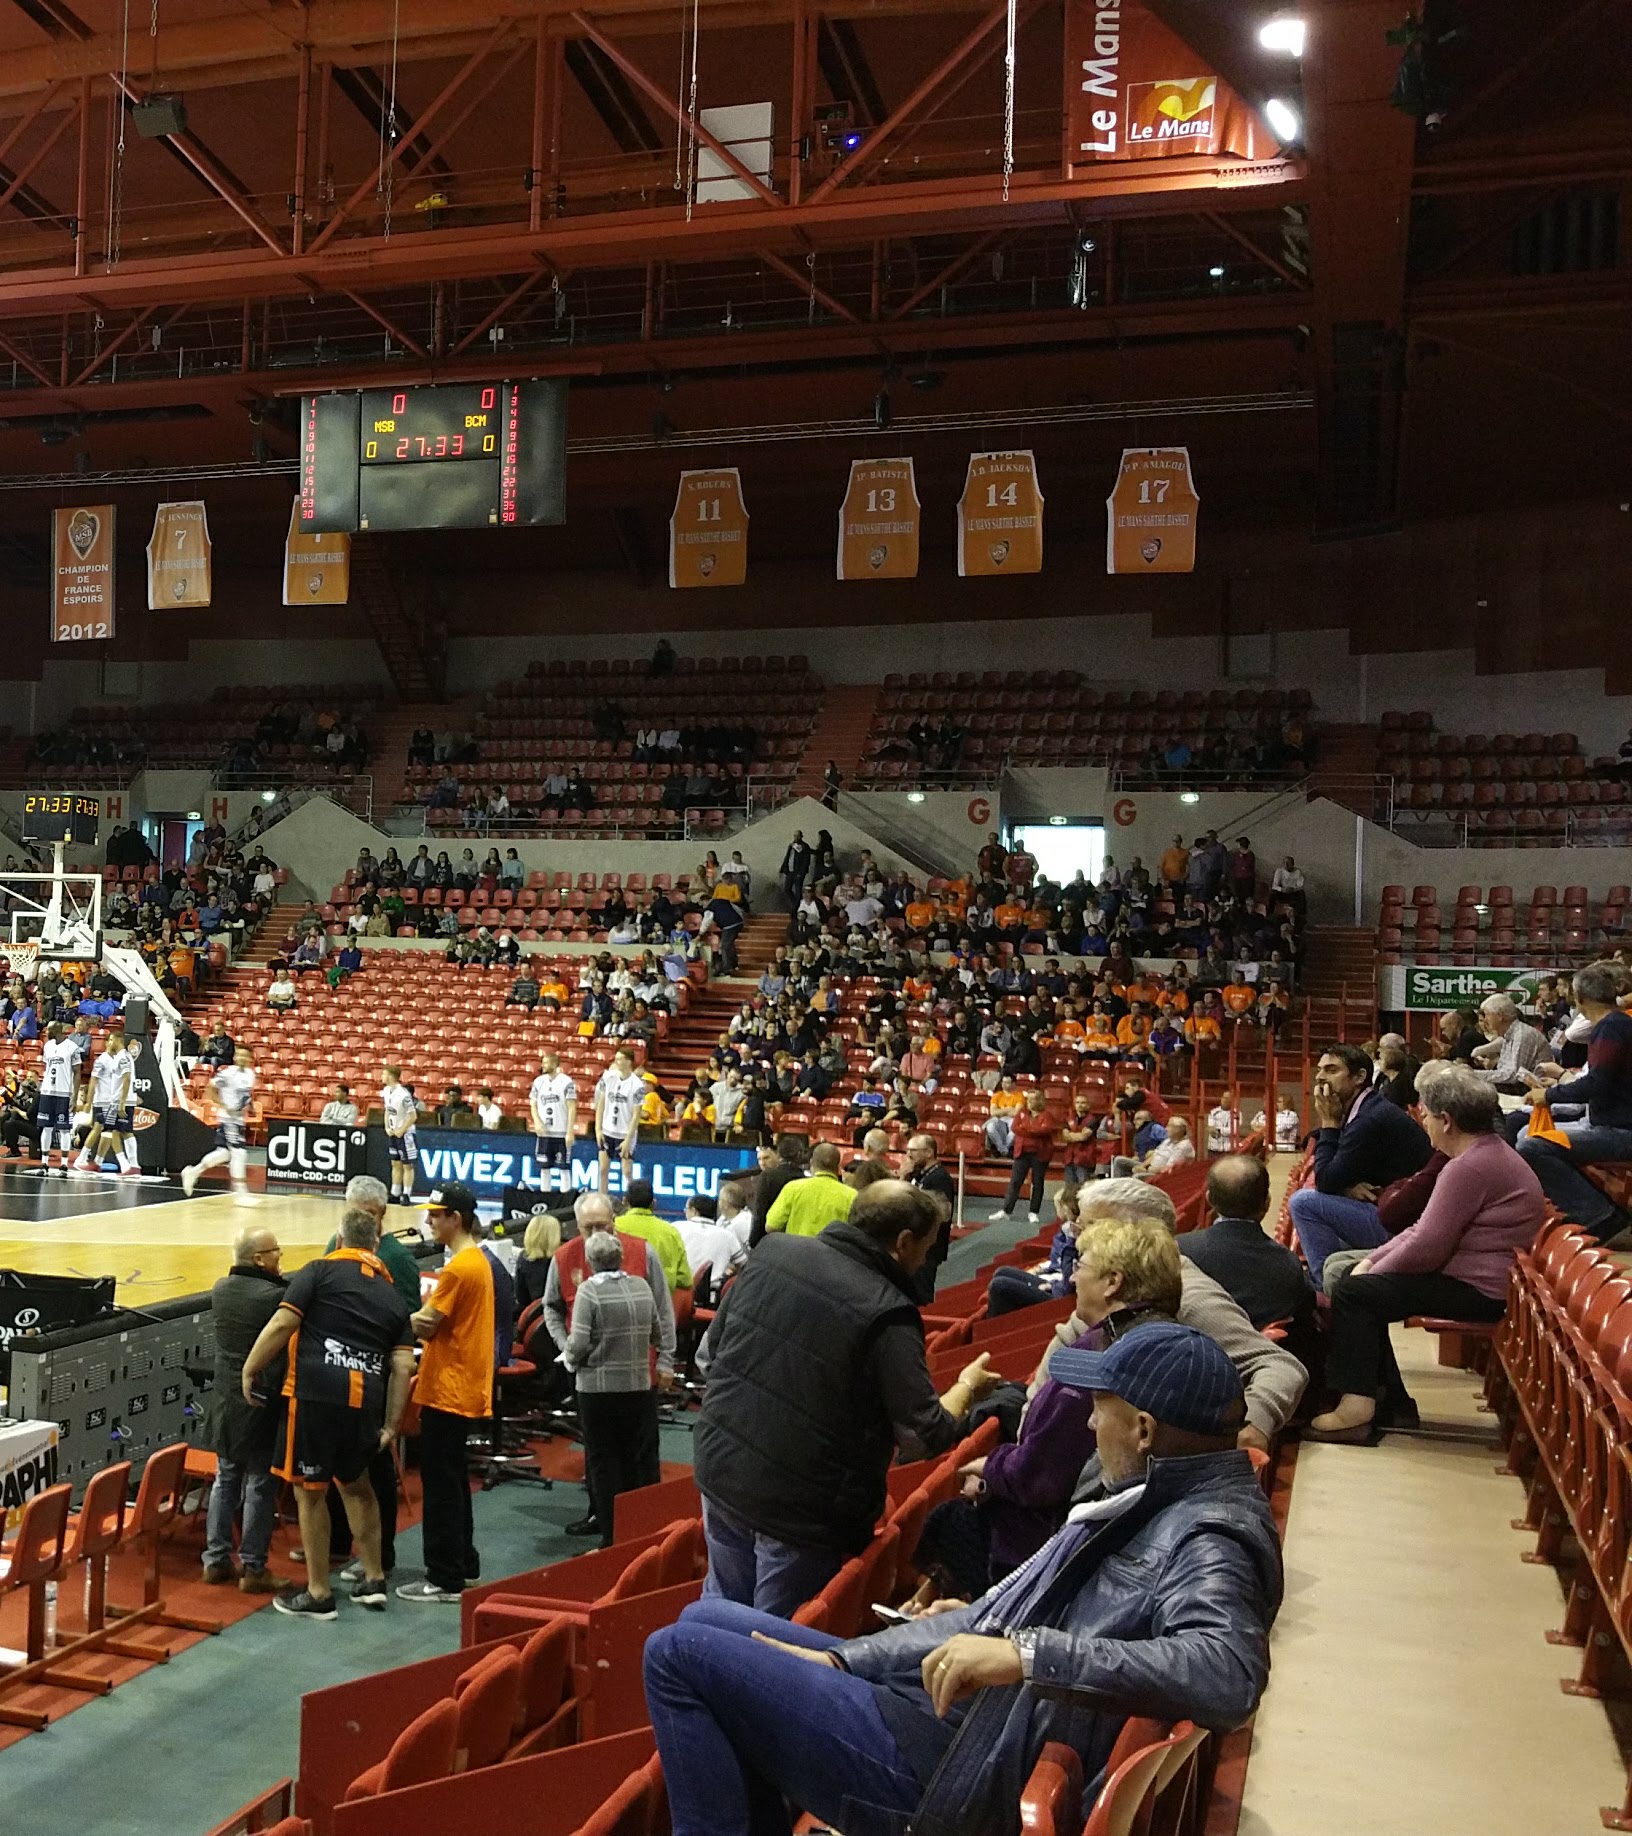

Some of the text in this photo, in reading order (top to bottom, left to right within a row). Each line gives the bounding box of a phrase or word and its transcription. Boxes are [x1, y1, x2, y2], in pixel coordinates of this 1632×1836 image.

[1081, 109, 1117, 152] Le
[1131, 119, 1210, 140] Le Mans
[393, 394, 407, 414] 0
[481, 388, 495, 409] 0
[374, 420, 395, 433] MSB
[465, 415, 487, 428] BCM
[367, 435, 495, 458] 0 27:33 0
[867, 488, 896, 512] 13
[986, 482, 1018, 507] 14
[1138, 480, 1170, 504] 17
[697, 498, 721, 521] 11
[175, 529, 187, 550] 7
[58, 563, 109, 575] CHAMPION
[77, 575, 90, 583] DE
[63, 594, 104, 605] ESPOIRS
[64, 584, 102, 594] FRANCE
[58, 622, 107, 640] 2012
[25, 797, 71, 813] 27:33
[106, 797, 122, 819] H
[213, 797, 228, 819] H
[968, 798, 990, 825] G
[1113, 798, 1137, 826] G
[1412, 971, 1497, 995] Sarthe
[268, 1126, 347, 1171] dlsi
[420, 1148, 513, 1184] VIVEZ
